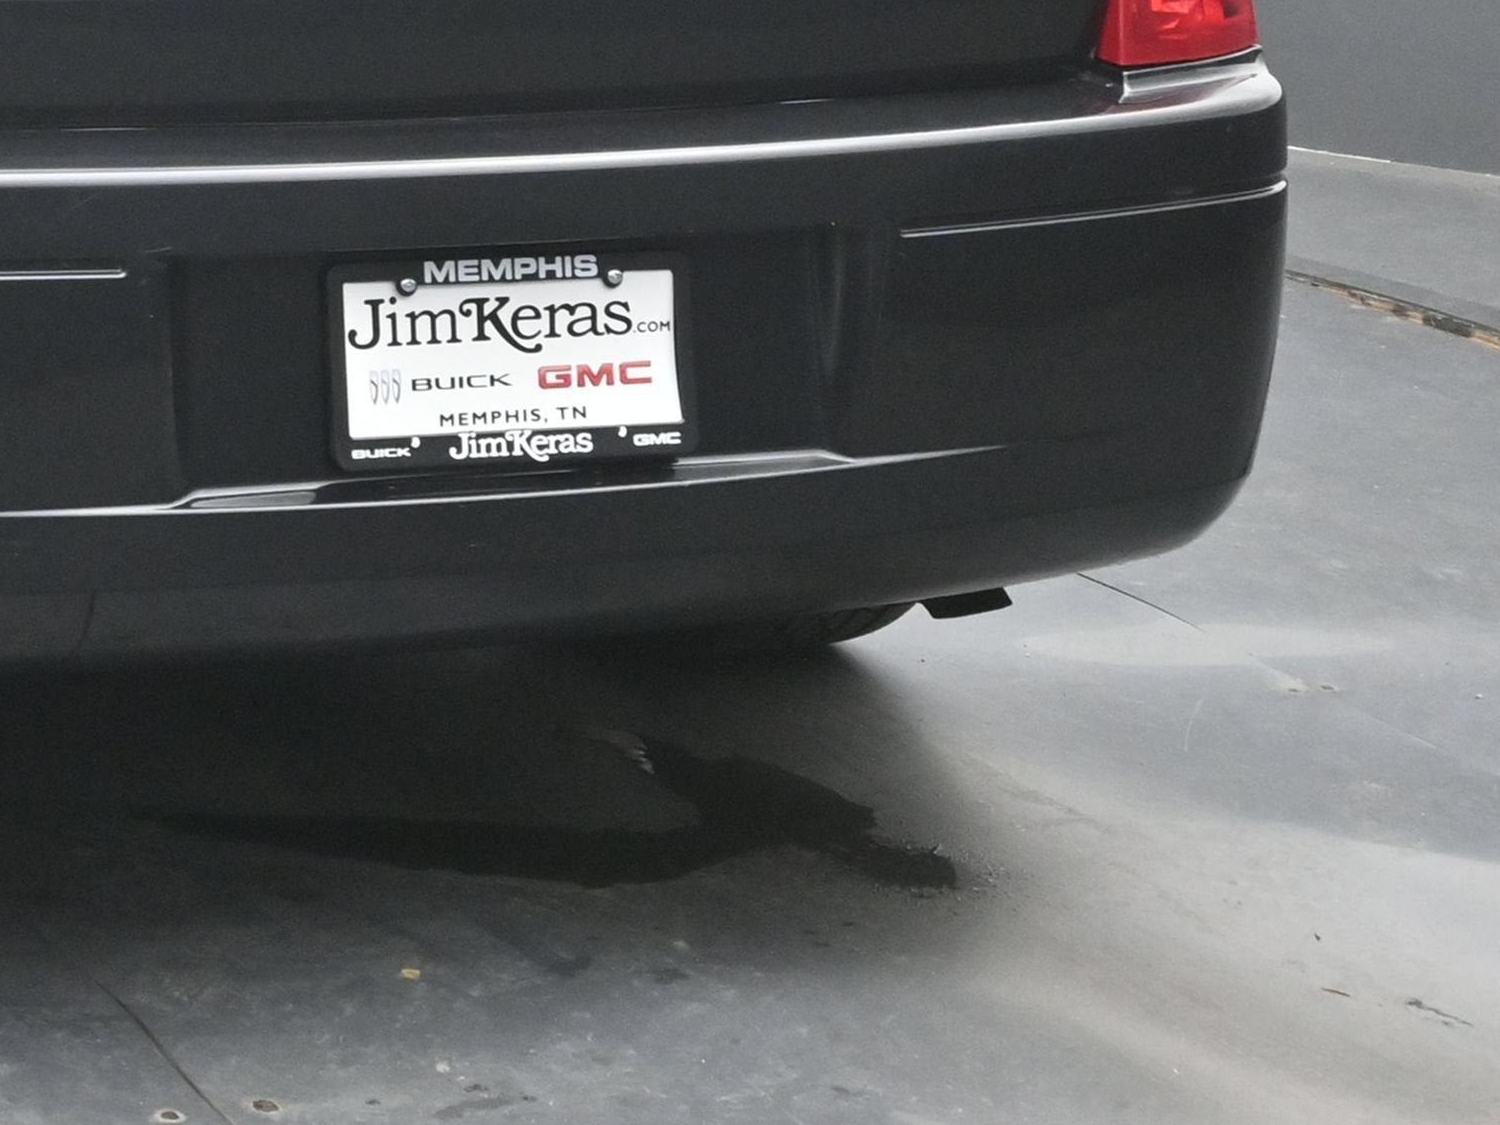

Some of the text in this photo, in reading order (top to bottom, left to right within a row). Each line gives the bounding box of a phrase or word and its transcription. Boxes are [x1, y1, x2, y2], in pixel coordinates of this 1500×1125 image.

[423, 254, 598, 284] MEMPHIS
[411, 361, 653, 392] BUICK GMC
[439, 406, 587, 427] MEMPHIS, TN
[351, 447, 411, 459] BUICK
[633, 431, 681, 446] GMC
